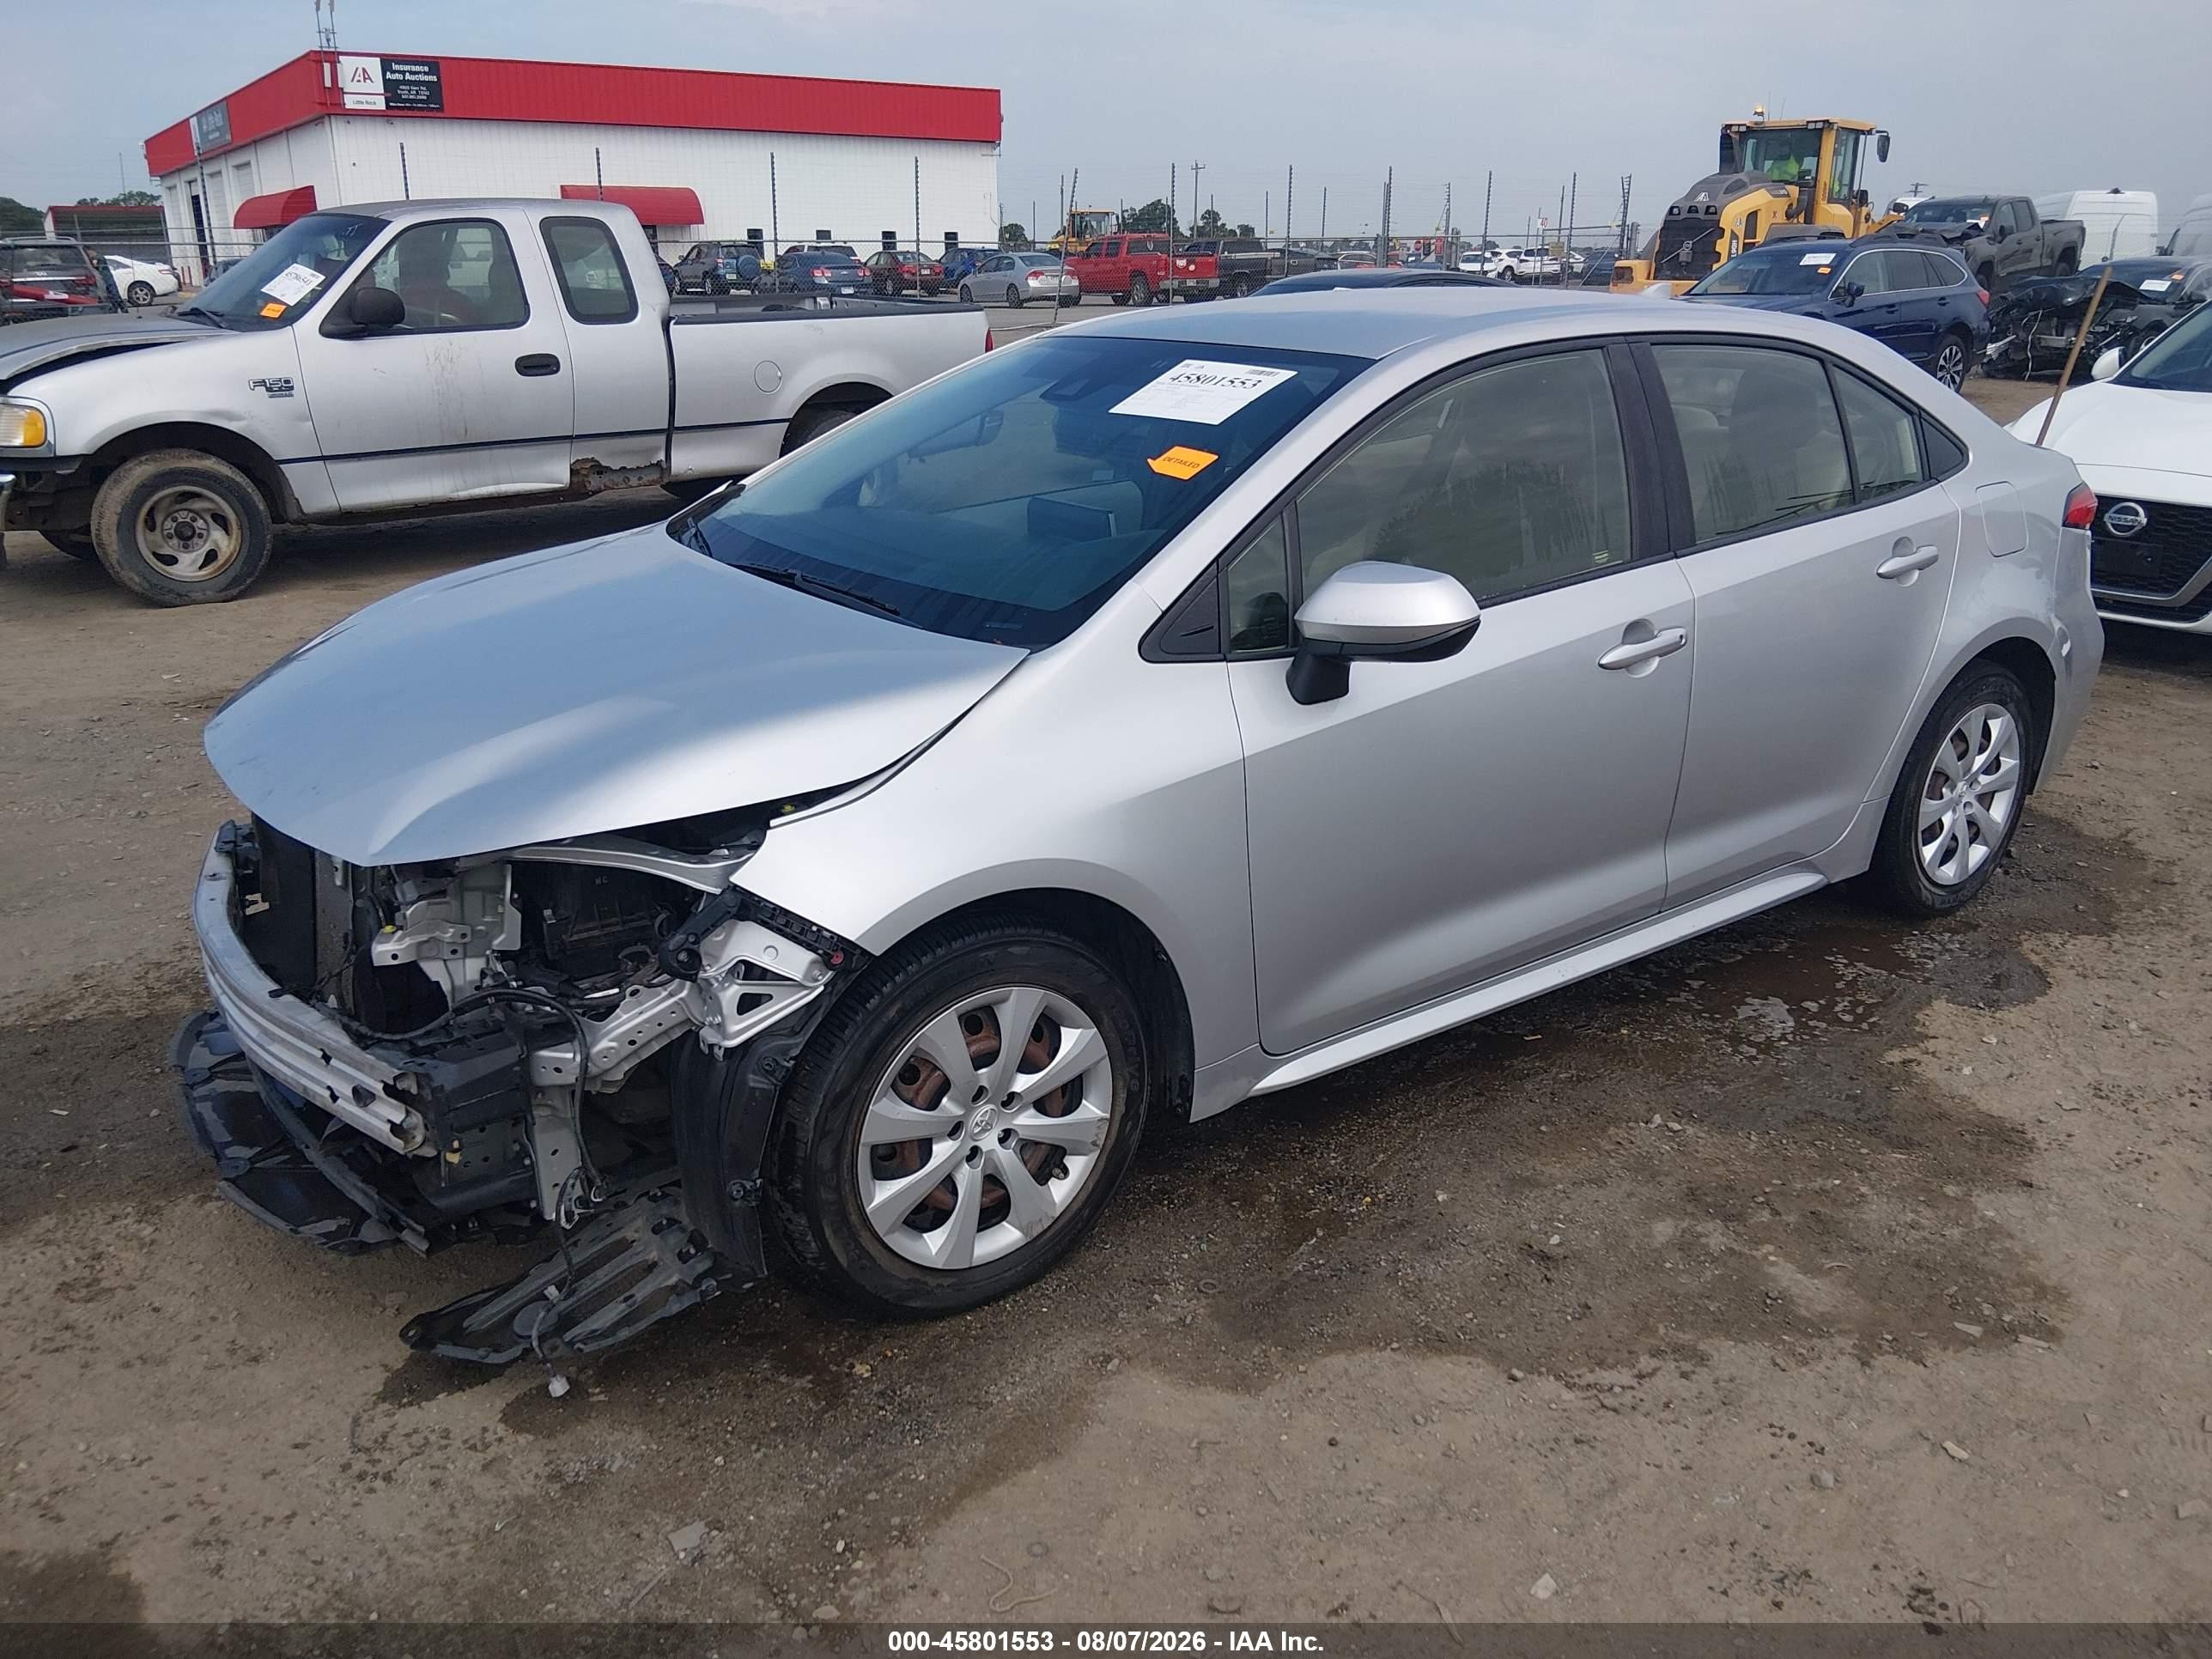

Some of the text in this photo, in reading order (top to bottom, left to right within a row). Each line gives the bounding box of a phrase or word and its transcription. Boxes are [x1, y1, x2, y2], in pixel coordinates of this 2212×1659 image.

[392, 62, 429, 72] Insurance
[386, 72, 438, 82] Auto Auctions
[1540, 219, 1548, 228] 40
[1170, 372, 1263, 390] 45801553
[1162, 456, 1200, 469] DETAILED
[2108, 515, 2142, 525] NISSAN
